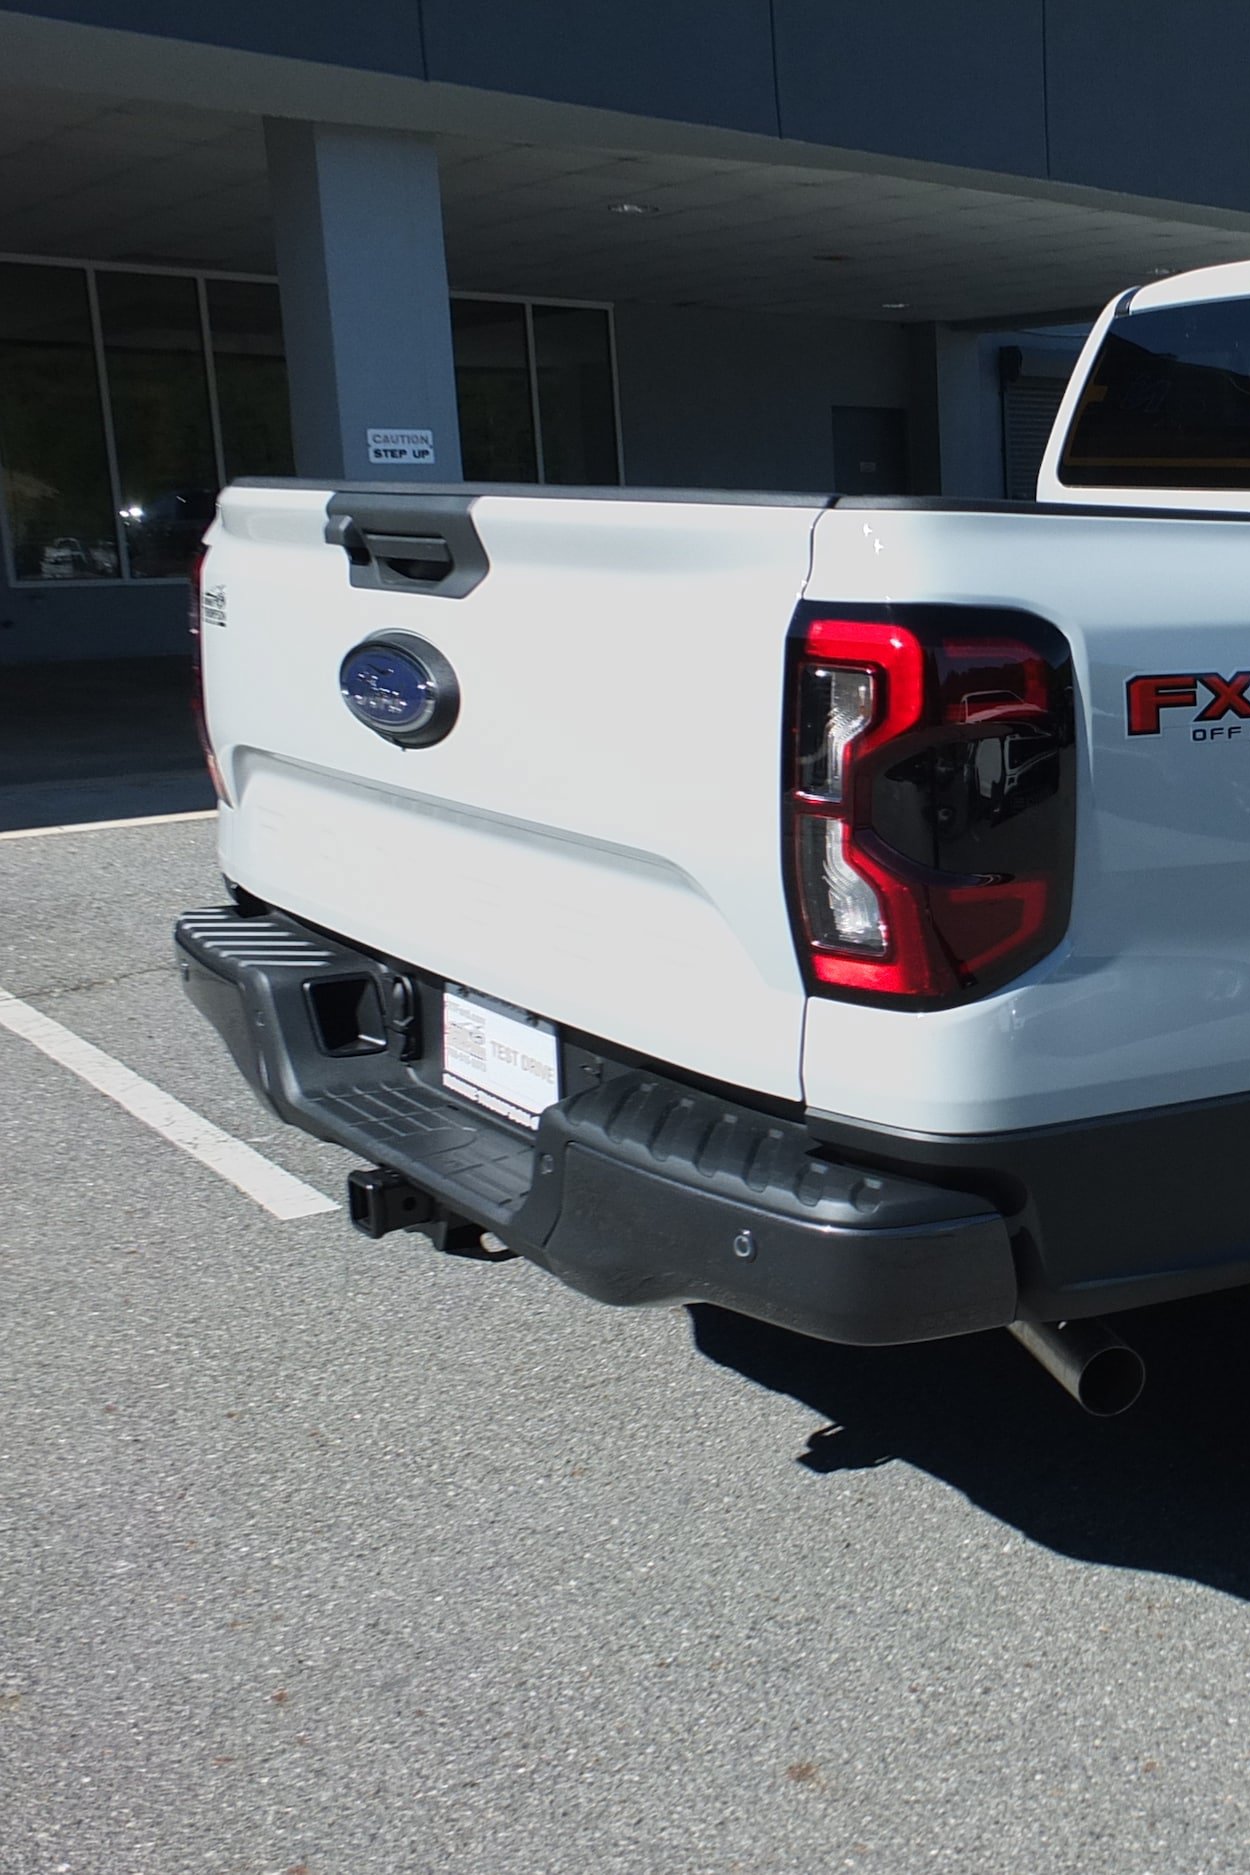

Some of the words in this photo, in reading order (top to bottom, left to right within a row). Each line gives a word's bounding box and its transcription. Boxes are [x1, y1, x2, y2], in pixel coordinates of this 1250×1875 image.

[372, 434, 429, 445] CAUTION
[374, 448, 407, 459] STEP
[412, 448, 430, 459] UP
[1192, 726, 1242, 742] OFF
[490, 1040, 519, 1067] TEST
[521, 1054, 555, 1085] DRIVE
